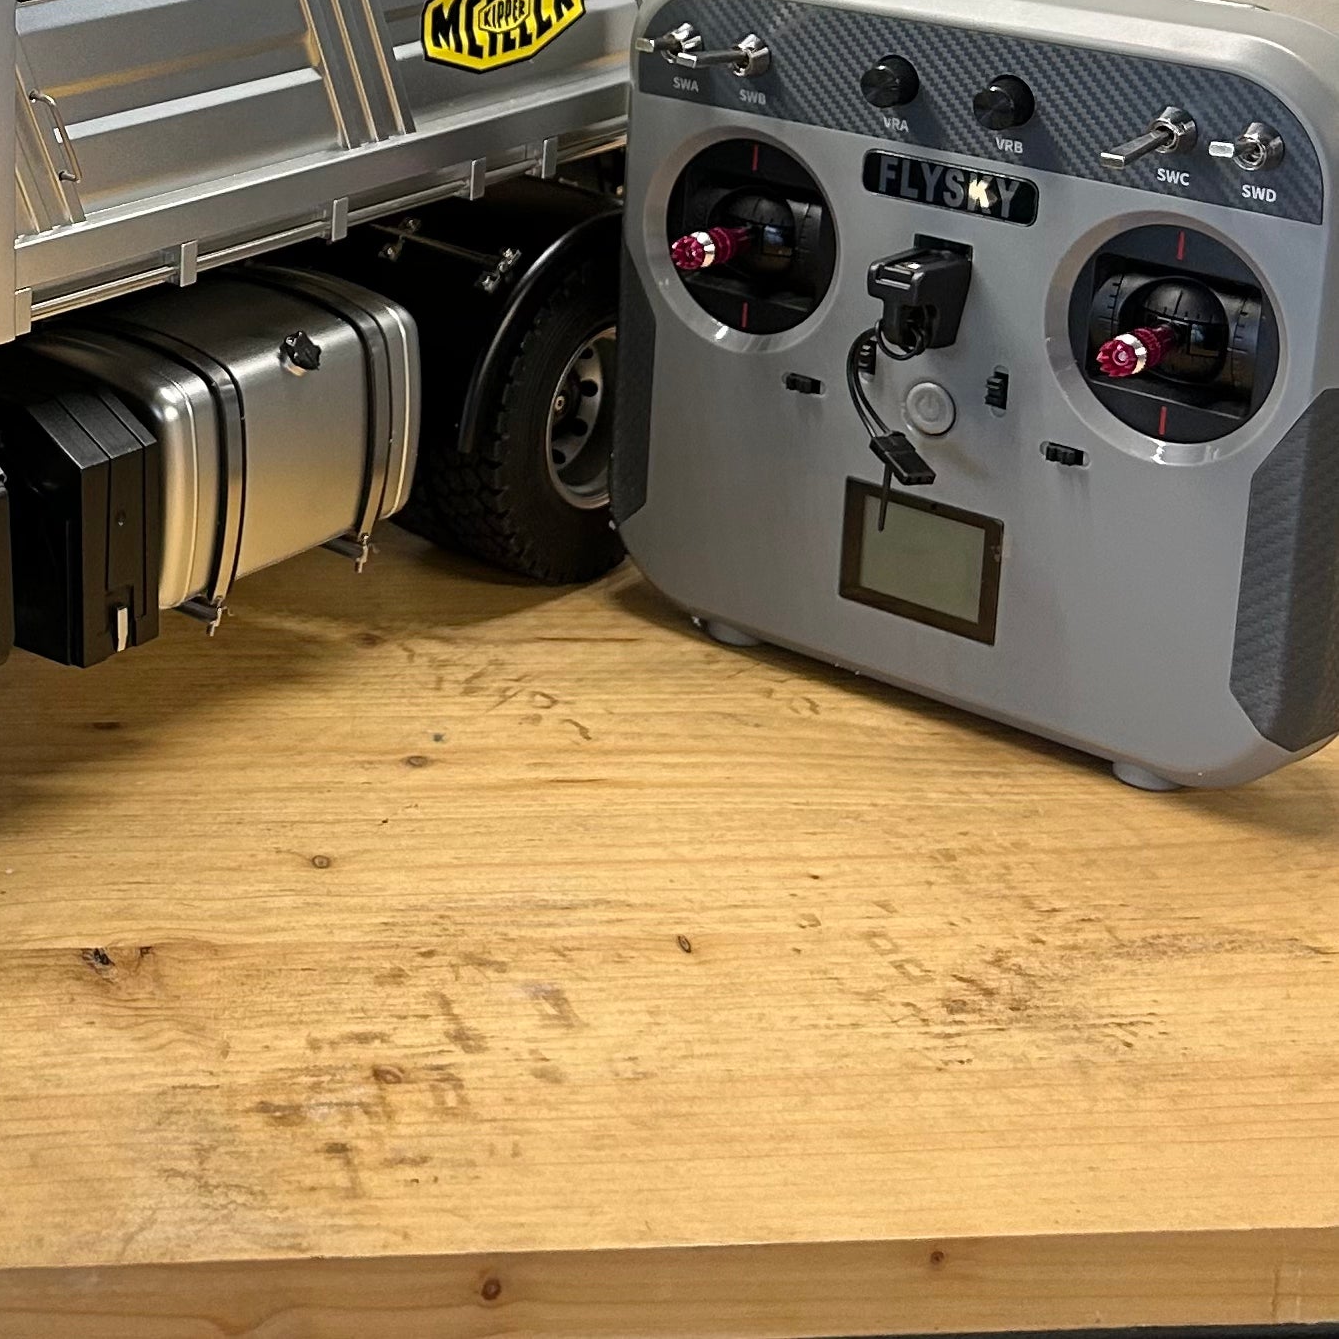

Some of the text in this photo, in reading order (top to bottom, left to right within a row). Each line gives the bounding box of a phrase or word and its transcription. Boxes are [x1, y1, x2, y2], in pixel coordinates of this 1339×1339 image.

[672, 76, 699, 93] SWA
[739, 88, 767, 105] SWB
[883, 116, 909, 133] VRA
[995, 136, 1023, 154] VRB
[1156, 168, 1190, 186] SWC
[878, 156, 1020, 219] FLYSKY
[1241, 184, 1277, 202] SWD
